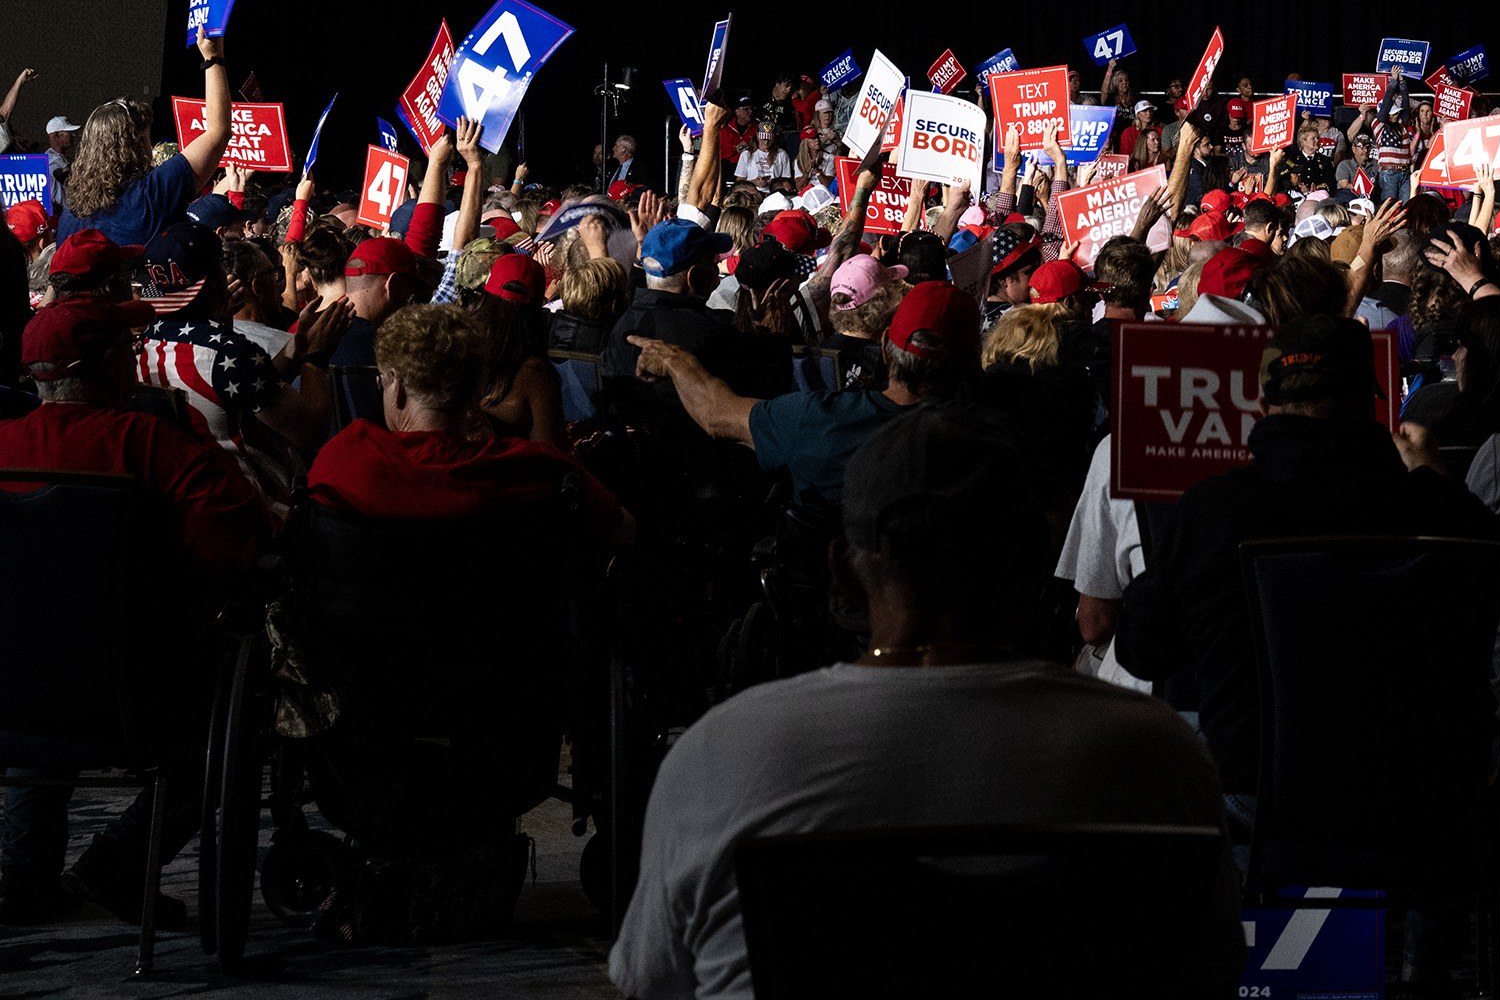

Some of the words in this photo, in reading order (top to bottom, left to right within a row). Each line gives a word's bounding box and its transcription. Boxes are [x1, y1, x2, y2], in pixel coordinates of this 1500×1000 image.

[1094, 30, 1124, 59] 47
[1384, 48, 1407, 56] SECURE
[457, 10, 532, 125] 47
[1382, 54, 1422, 64] BORDER
[1450, 53, 1484, 74] TRUMP
[822, 56, 851, 81] TRUMP
[825, 64, 852, 87] VANCE
[930, 57, 955, 85] TRUMP
[976, 56, 1012, 82] TRUMP
[867, 84, 894, 114] SECUR
[1017, 82, 1049, 100] TEXT
[1288, 88, 1330, 100] TRUMP
[1352, 96, 1378, 104] AGAIN!
[1438, 93, 1465, 107] AMERICA
[1444, 88, 1462, 98] MAKE
[860, 98, 885, 130] BOR
[1013, 100, 1056, 118] TRUMP
[1266, 100, 1287, 114] MAKE
[1438, 108, 1460, 118] AGAIN!
[1440, 100, 1460, 112] GREAT
[190, 118, 272, 136] ARICA
[1006, 121, 1024, 136] TO
[1028, 116, 1064, 135] 88022
[1259, 112, 1290, 126] AMERICA
[1264, 121, 1287, 135] GREAT
[916, 118, 976, 143] SECURE
[1071, 122, 1108, 136] UMP
[913, 132, 980, 163] BORD
[881, 176, 911, 192] EXT
[868, 190, 910, 208] TRUM
[1086, 182, 1138, 209] MAKE
[1090, 215, 1139, 240] GREA
[1280, 353, 1321, 366] TRUMP
[1131, 365, 1264, 412] TRU
[1146, 446, 1186, 458] MAKE
[1238, 986, 1271, 997] 024
